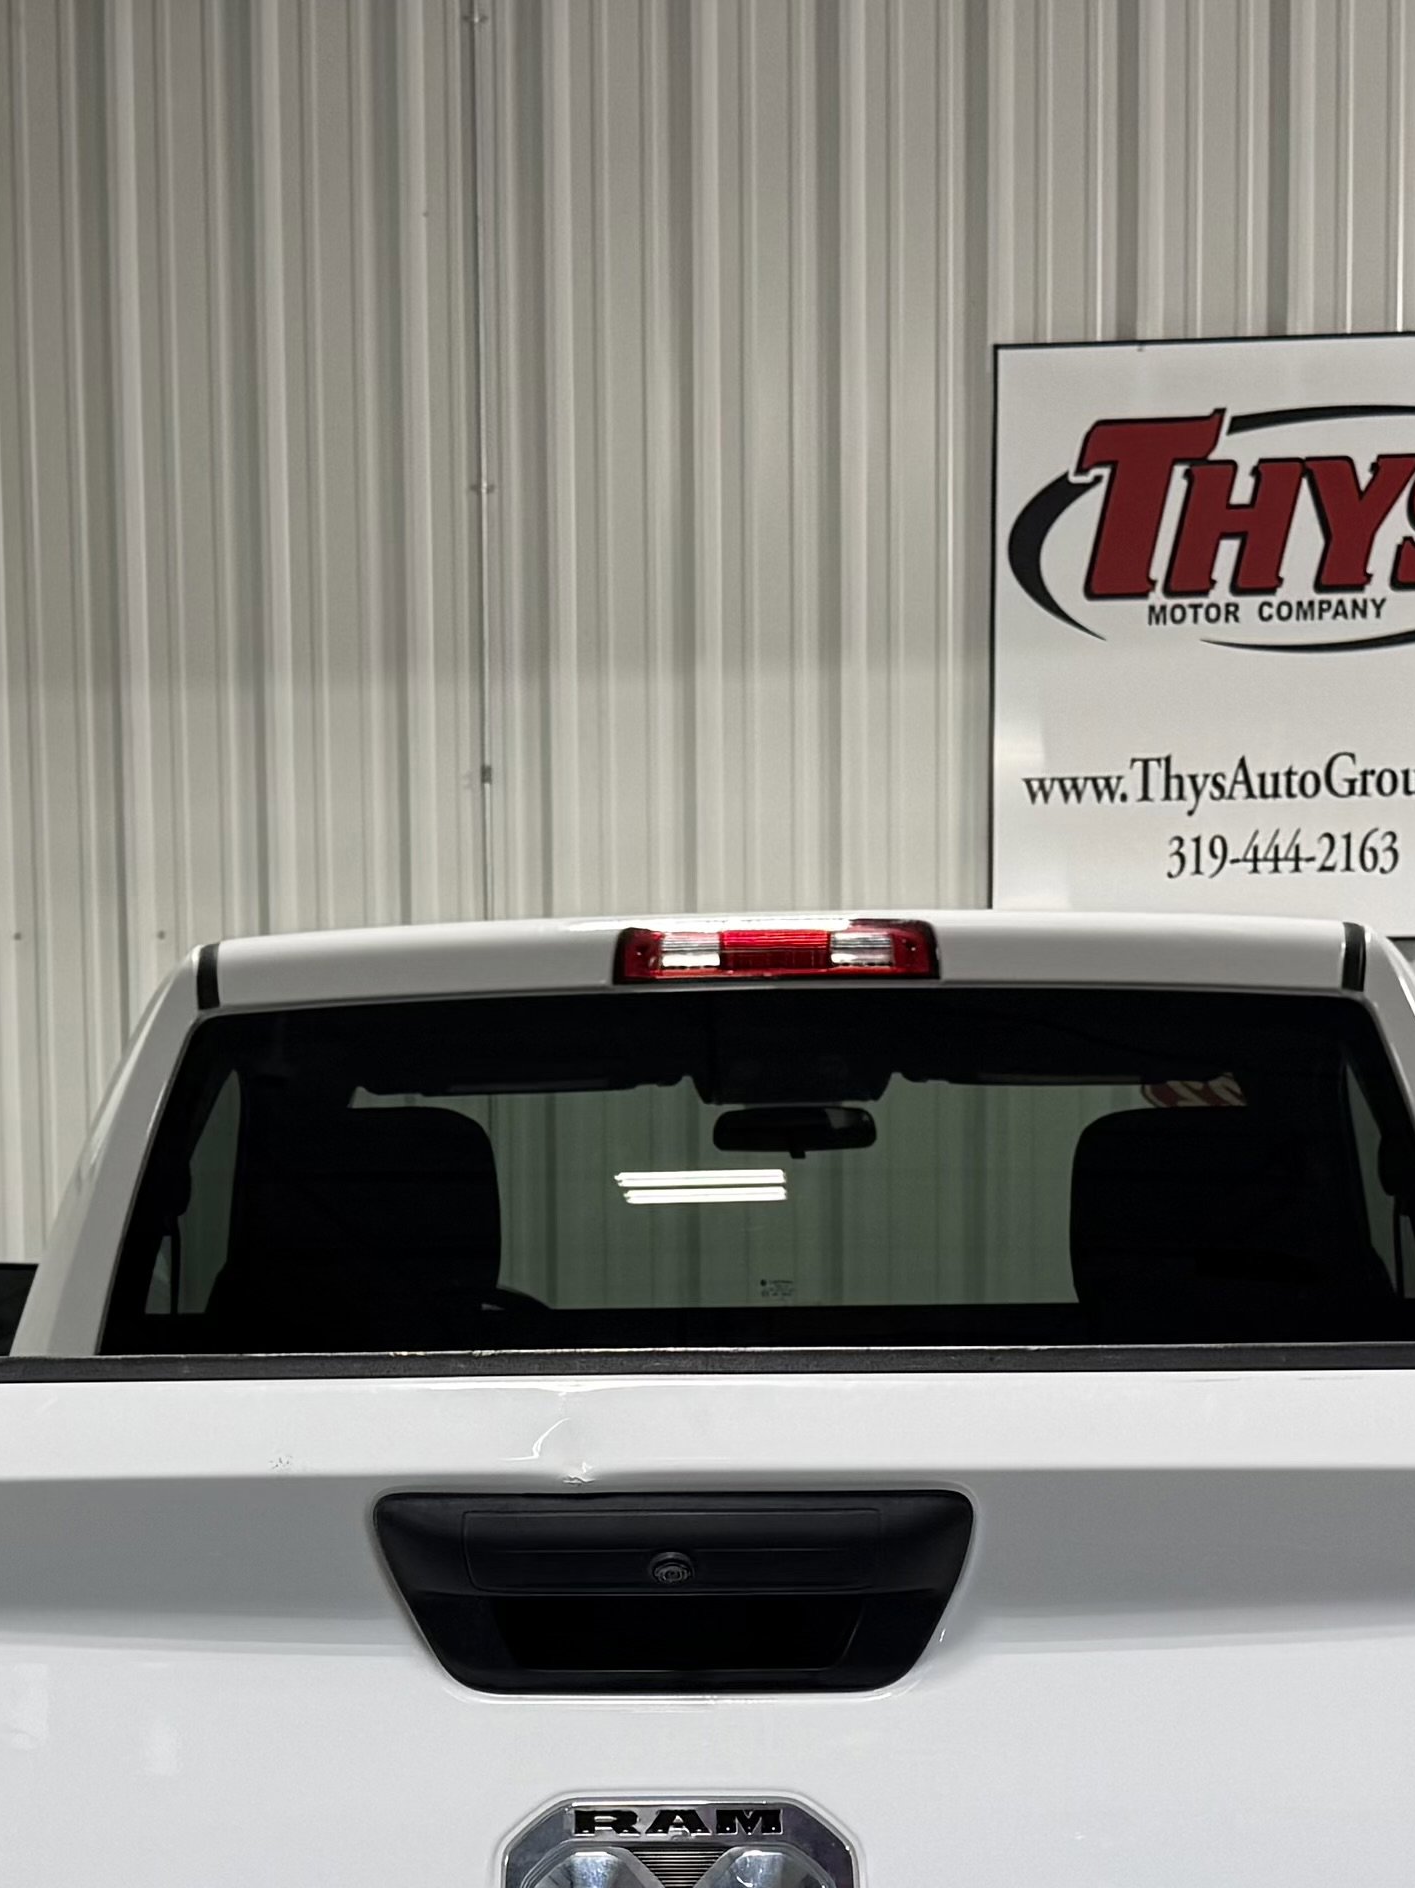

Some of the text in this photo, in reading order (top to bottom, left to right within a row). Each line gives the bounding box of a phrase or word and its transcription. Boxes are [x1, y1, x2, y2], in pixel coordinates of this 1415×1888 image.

[1147, 598, 1387, 626] MOTOR COMPANY
[1166, 827, 1401, 879] 319-444-2163
[573, 1808, 784, 1836] RAM
